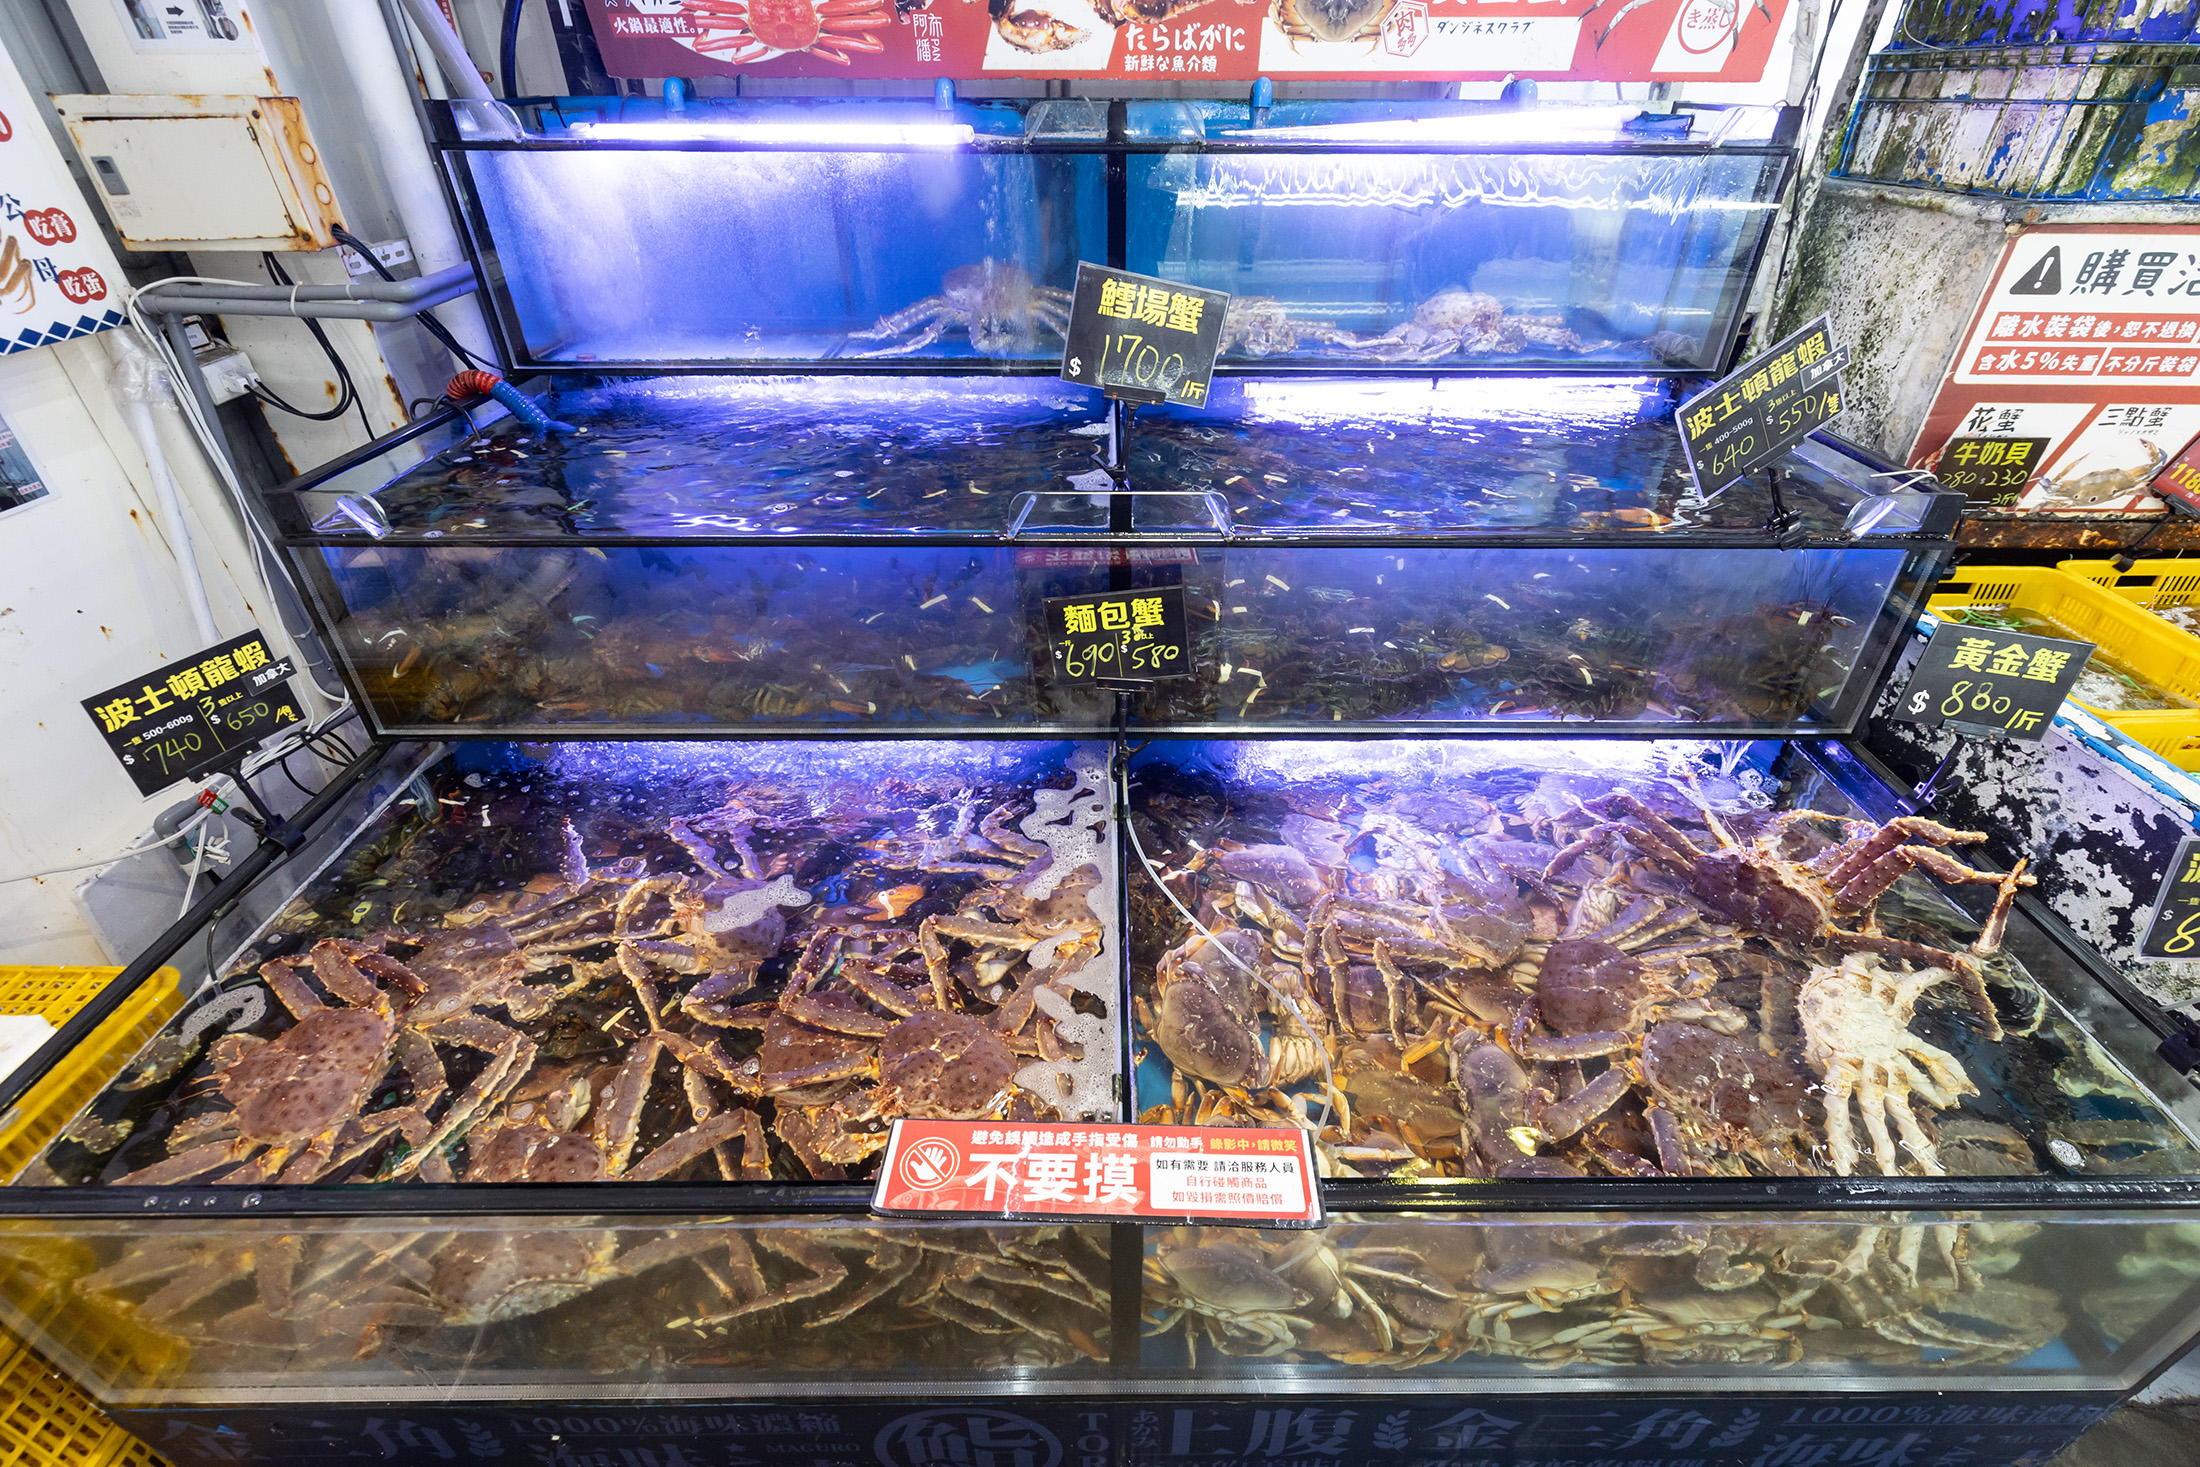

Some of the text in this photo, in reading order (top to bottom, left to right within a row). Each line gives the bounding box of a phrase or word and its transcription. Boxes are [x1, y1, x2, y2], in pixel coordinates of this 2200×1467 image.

[614, 17, 695, 34] 火鍋最適性。
[1126, 22, 1245, 51] たらばがに
[1437, 20, 1534, 35] ダンジネスクラブ
[1124, 54, 1217, 72] 新鮮な魚介類
[29, 214, 72, 239] 吃膏
[33, 257, 104, 298] 母 吃蛋
[1098, 278, 1205, 334] 鱈場蟹
[1068, 356, 1082, 377] $
[1977, 349, 2198, 373] 含水5%失重 不分斤裝袋
[1686, 331, 1846, 440] 波士頓龍蝦 加拿大
[1779, 395, 1816, 434] 550
[1968, 407, 2024, 432] 花蟹
[2098, 407, 2172, 427] 三點蟹
[1714, 417, 1754, 444] 400-500g
[1713, 435, 1755, 475] 640
[1953, 441, 2033, 466] 牛奶貝
[1985, 469, 2028, 486] 230
[1063, 597, 1165, 635] 麵包蟹
[1066, 643, 1114, 677] 690
[1132, 643, 1179, 669] 580
[1948, 637, 2072, 683] 黃金蟹
[94, 640, 292, 734] 波士頓龍蝦 加拿大
[1907, 689, 1930, 715] $
[1941, 680, 2011, 716] 880
[142, 713, 194, 740] 500-600g
[227, 702, 269, 730] 650
[142, 733, 202, 775] 740
[971, 1130, 1139, 1148] 避免誤觸造成手指受傷
[1150, 1136, 1203, 1149] 請勿動手
[964, 1152, 1138, 1204] 不要摸
[1156, 1159, 1295, 1174] 如有需要 請洽服務人員
[1186, 1175, 1268, 1189] 自行碰觸商品
[1172, 1191, 1283, 1205] 如毀損需照價賠償
[1170, 1408, 1360, 1457] 上腹
[1424, 1408, 1713, 1450] 金三角
